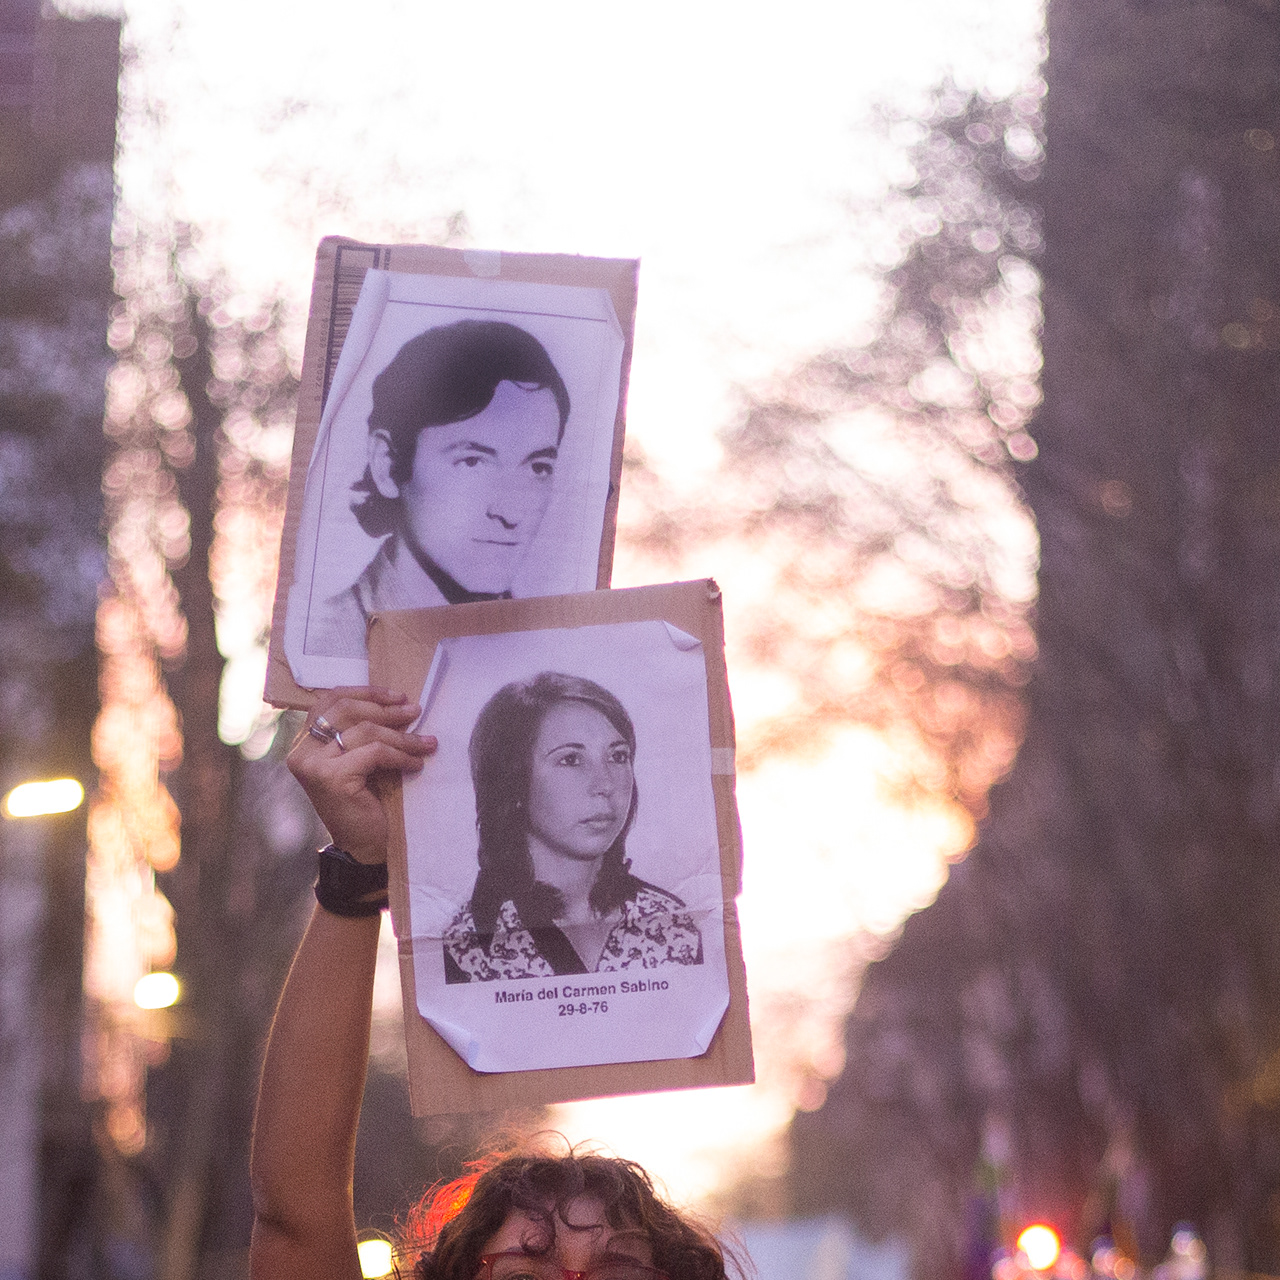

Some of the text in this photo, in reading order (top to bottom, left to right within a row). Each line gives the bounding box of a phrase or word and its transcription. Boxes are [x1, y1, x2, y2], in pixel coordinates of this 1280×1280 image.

[495, 979, 669, 1003] María del Carmen Sabino
[558, 1001, 609, 1017] 29-8-76
